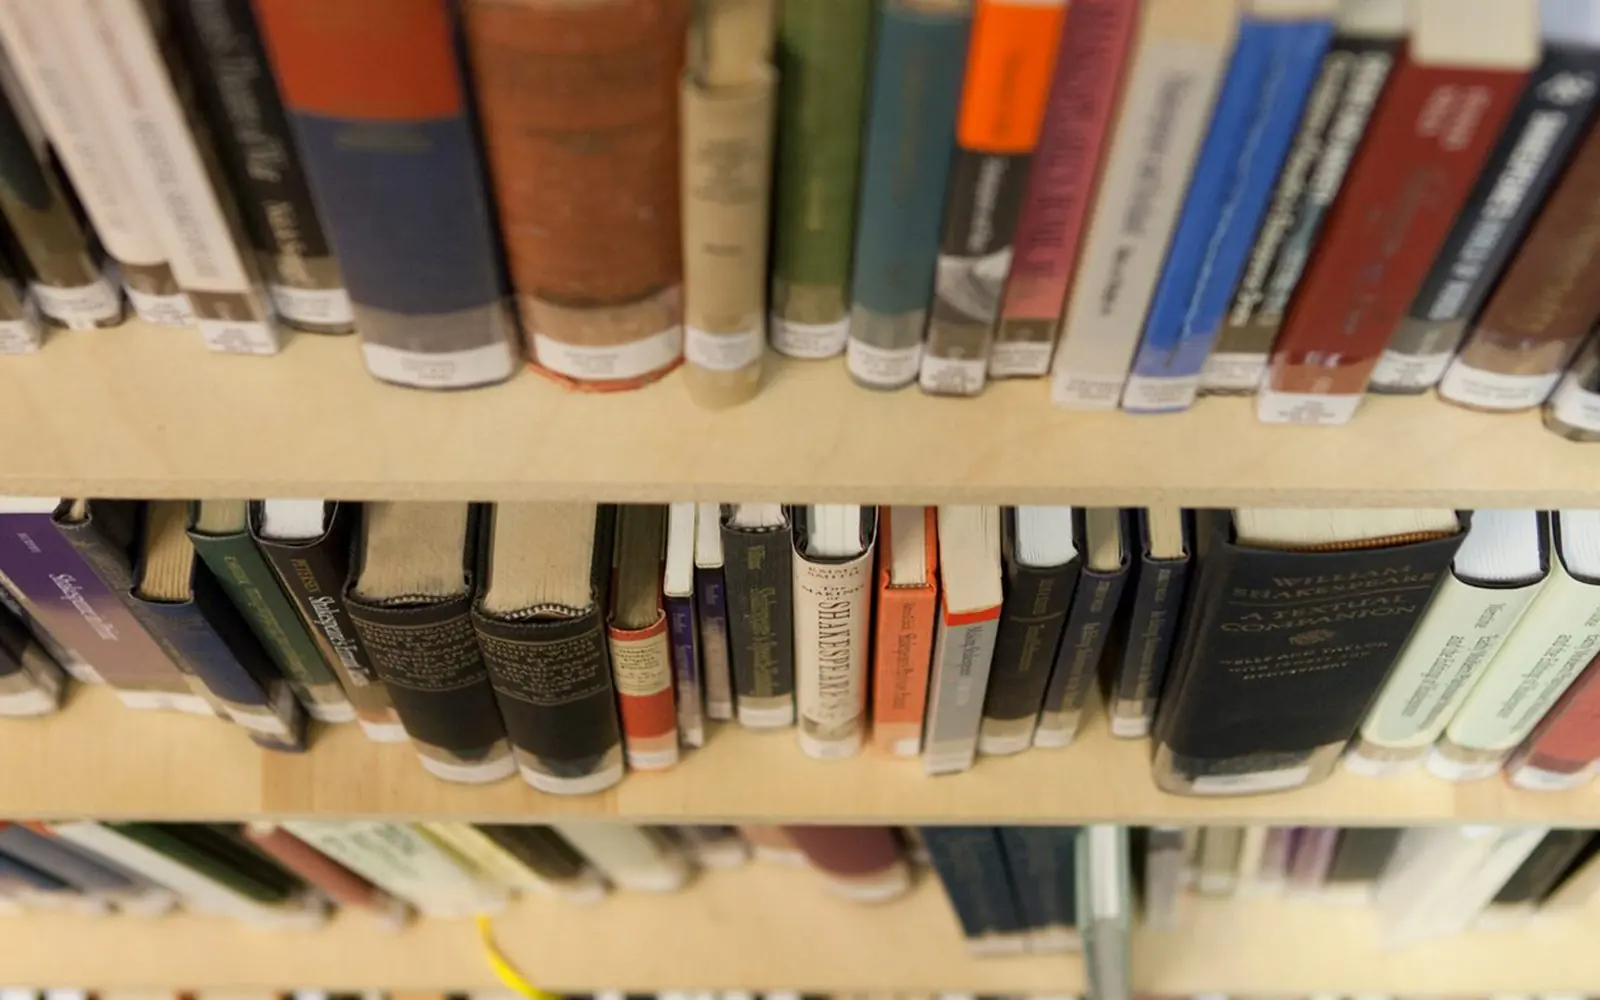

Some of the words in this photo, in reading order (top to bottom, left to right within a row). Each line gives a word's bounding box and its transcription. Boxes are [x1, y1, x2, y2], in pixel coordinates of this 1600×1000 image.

[1231, 572, 1437, 599] SHAKESPEARE
[1271, 565, 1413, 586] WILLIAM
[1220, 605, 1416, 632] COMPANION
[1240, 611, 1263, 620] A
[1272, 595, 1407, 619] TEXTUAL
